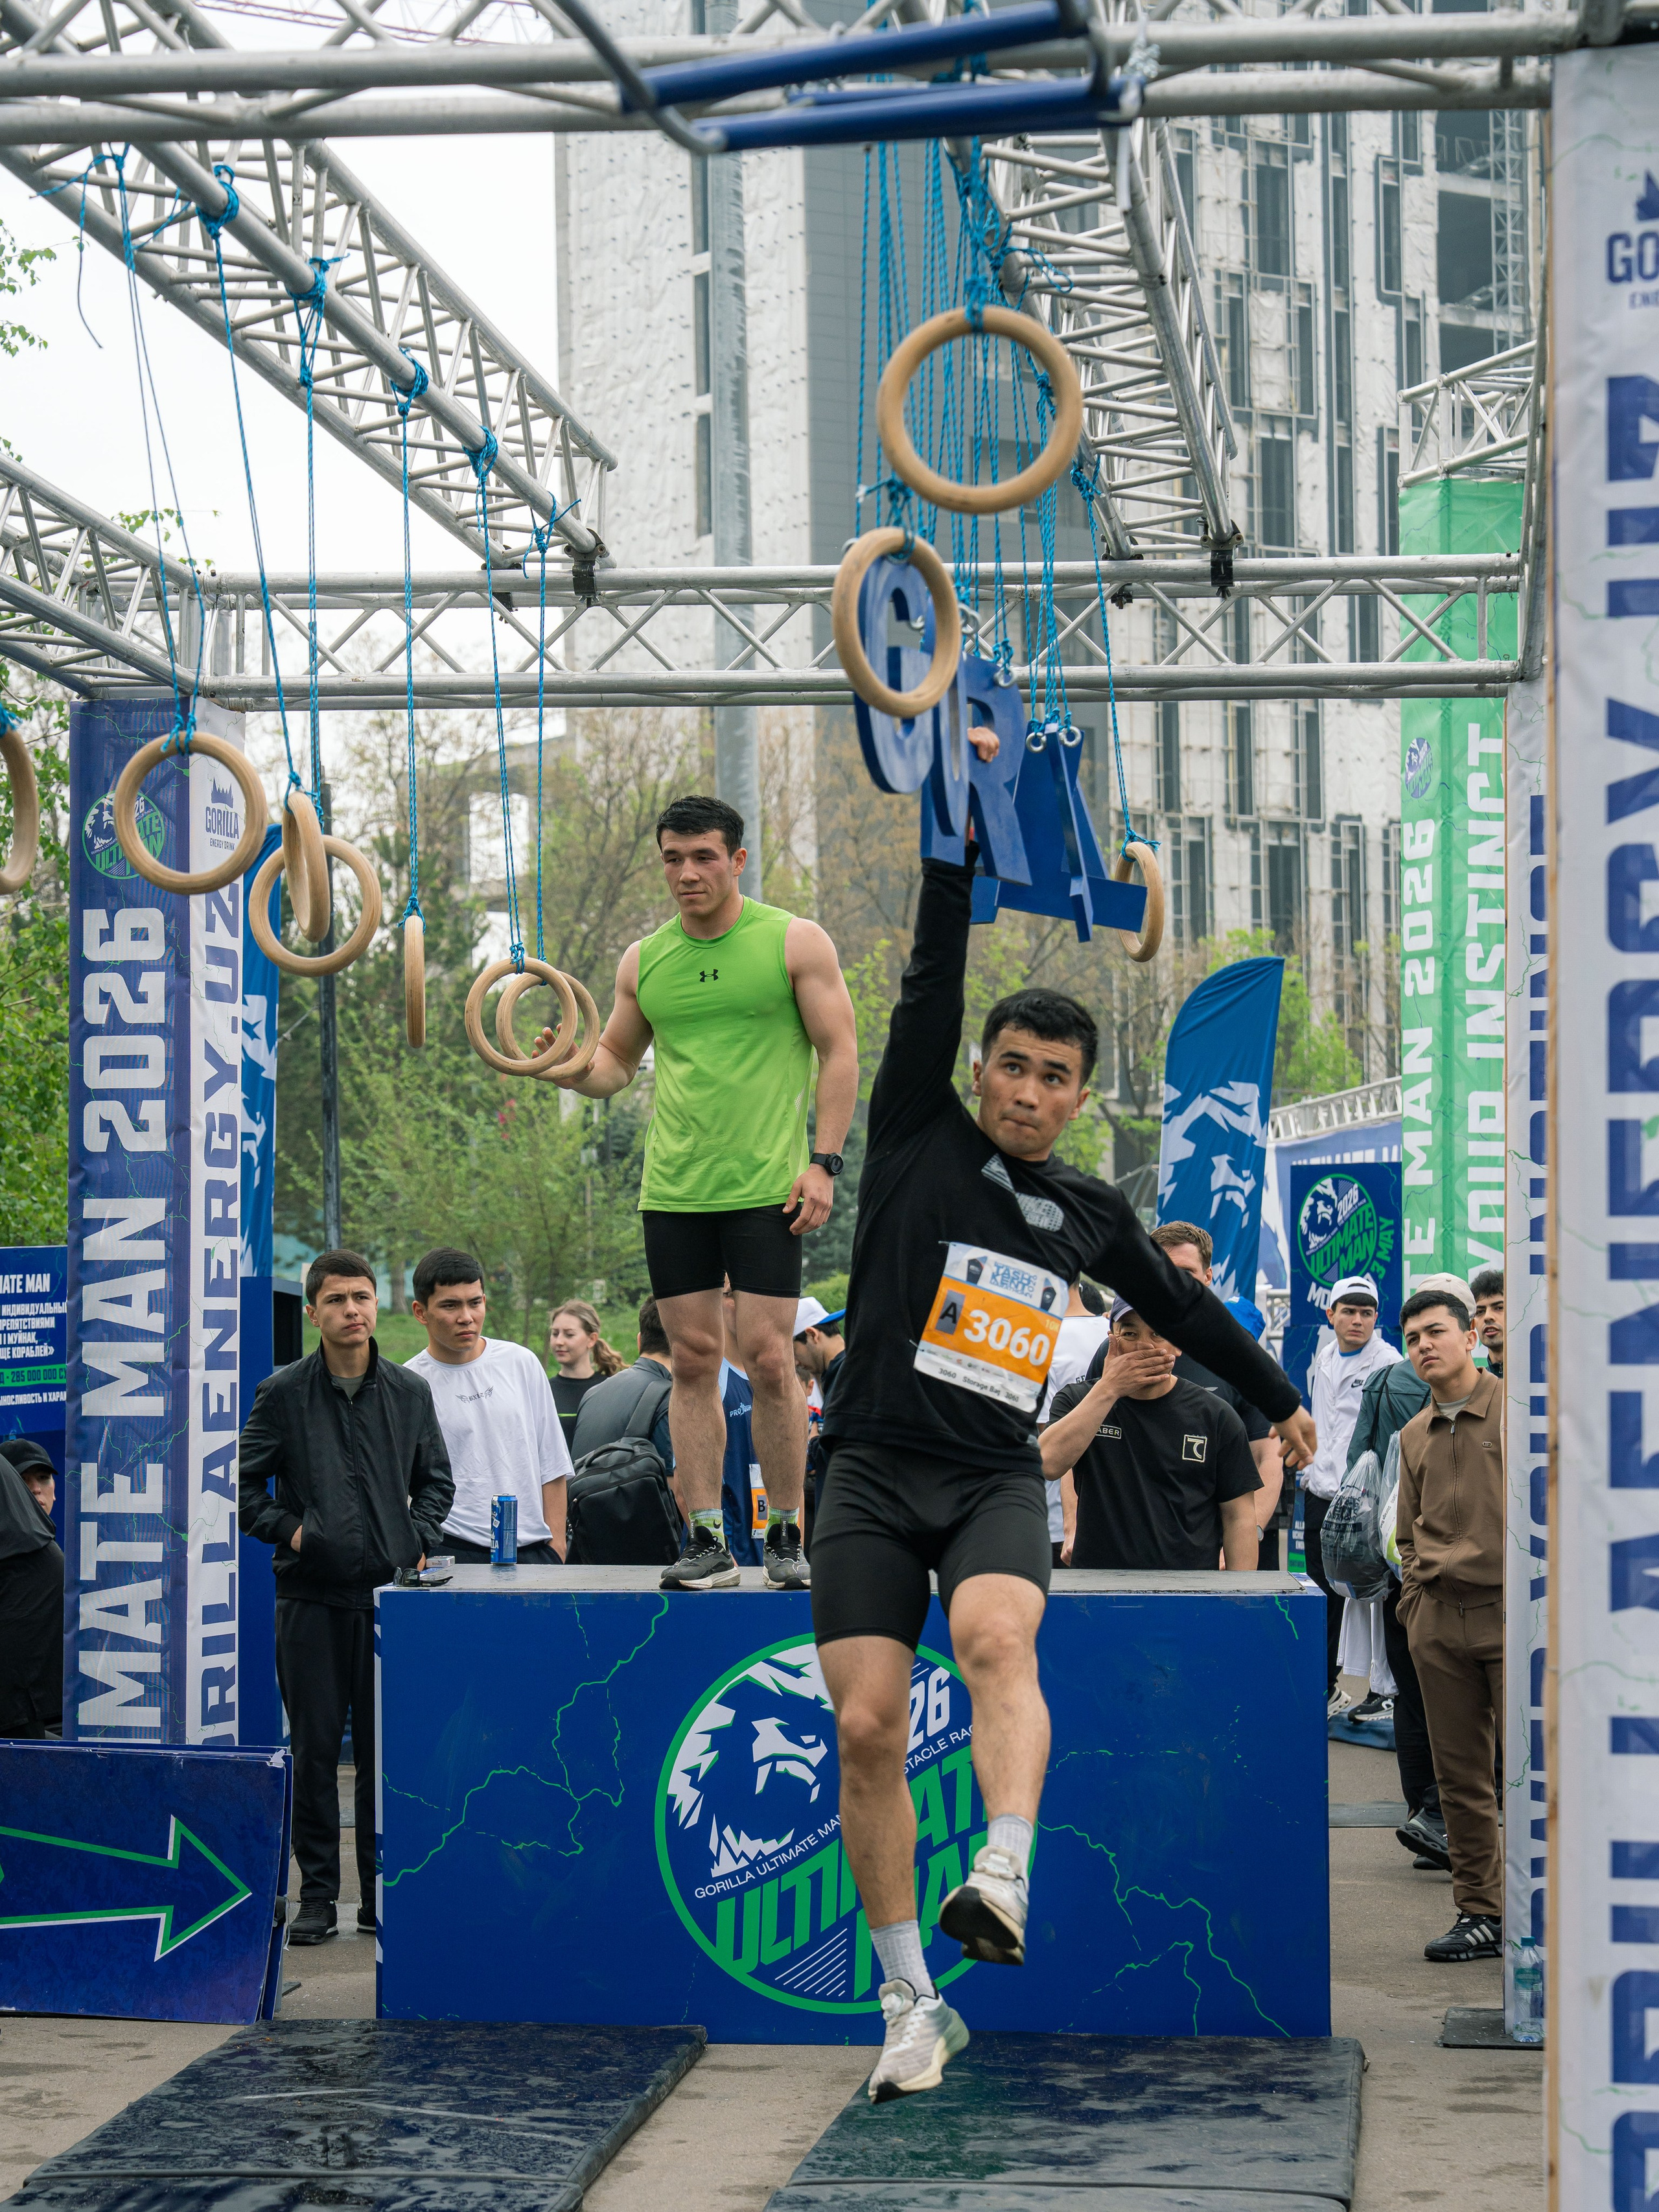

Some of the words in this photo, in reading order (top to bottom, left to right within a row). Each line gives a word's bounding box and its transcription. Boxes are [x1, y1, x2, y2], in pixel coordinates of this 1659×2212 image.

[205, 806, 239, 839] GORILLA
[210, 837, 224, 848] ENERGY
[1404, 818, 1435, 998] 2026
[82, 907, 165, 1154] 2026
[1403, 1026, 1433, 1186] MAN
[1337, 1183, 1359, 1224] 2026
[1310, 1204, 1374, 1277] ULTIMATE
[1339, 1229, 1375, 1280] MAN
[1376, 1216, 1394, 1262] MAY
[25, 1273, 51, 1293] MAN
[1370, 1259, 1386, 1279] 3
[82, 1198, 166, 1417] MAN
[201, 883, 238, 1745] RILLAENERGY.UZ
[940, 1302, 958, 1324] A
[7, 1330, 38, 1345] МУЙНАК,
[12, 1342, 55, 1359] КОРАБЛЕЙ»
[964, 1309, 1050, 1366] 3060
[11, 1370, 25, 1383] 285
[27, 1369, 41, 1382] 000
[43, 1368, 57, 1380] 000
[938, 1368, 957, 1379] 3060
[962, 1375, 988, 1391] Storage
[989, 1385, 1001, 1397] Bag
[730, 1408, 741, 1417] PRO
[758, 1500, 765, 1513] B
[694, 1870, 756, 1899] GORILLA
[756, 1833, 819, 1876] ULTIMATE
